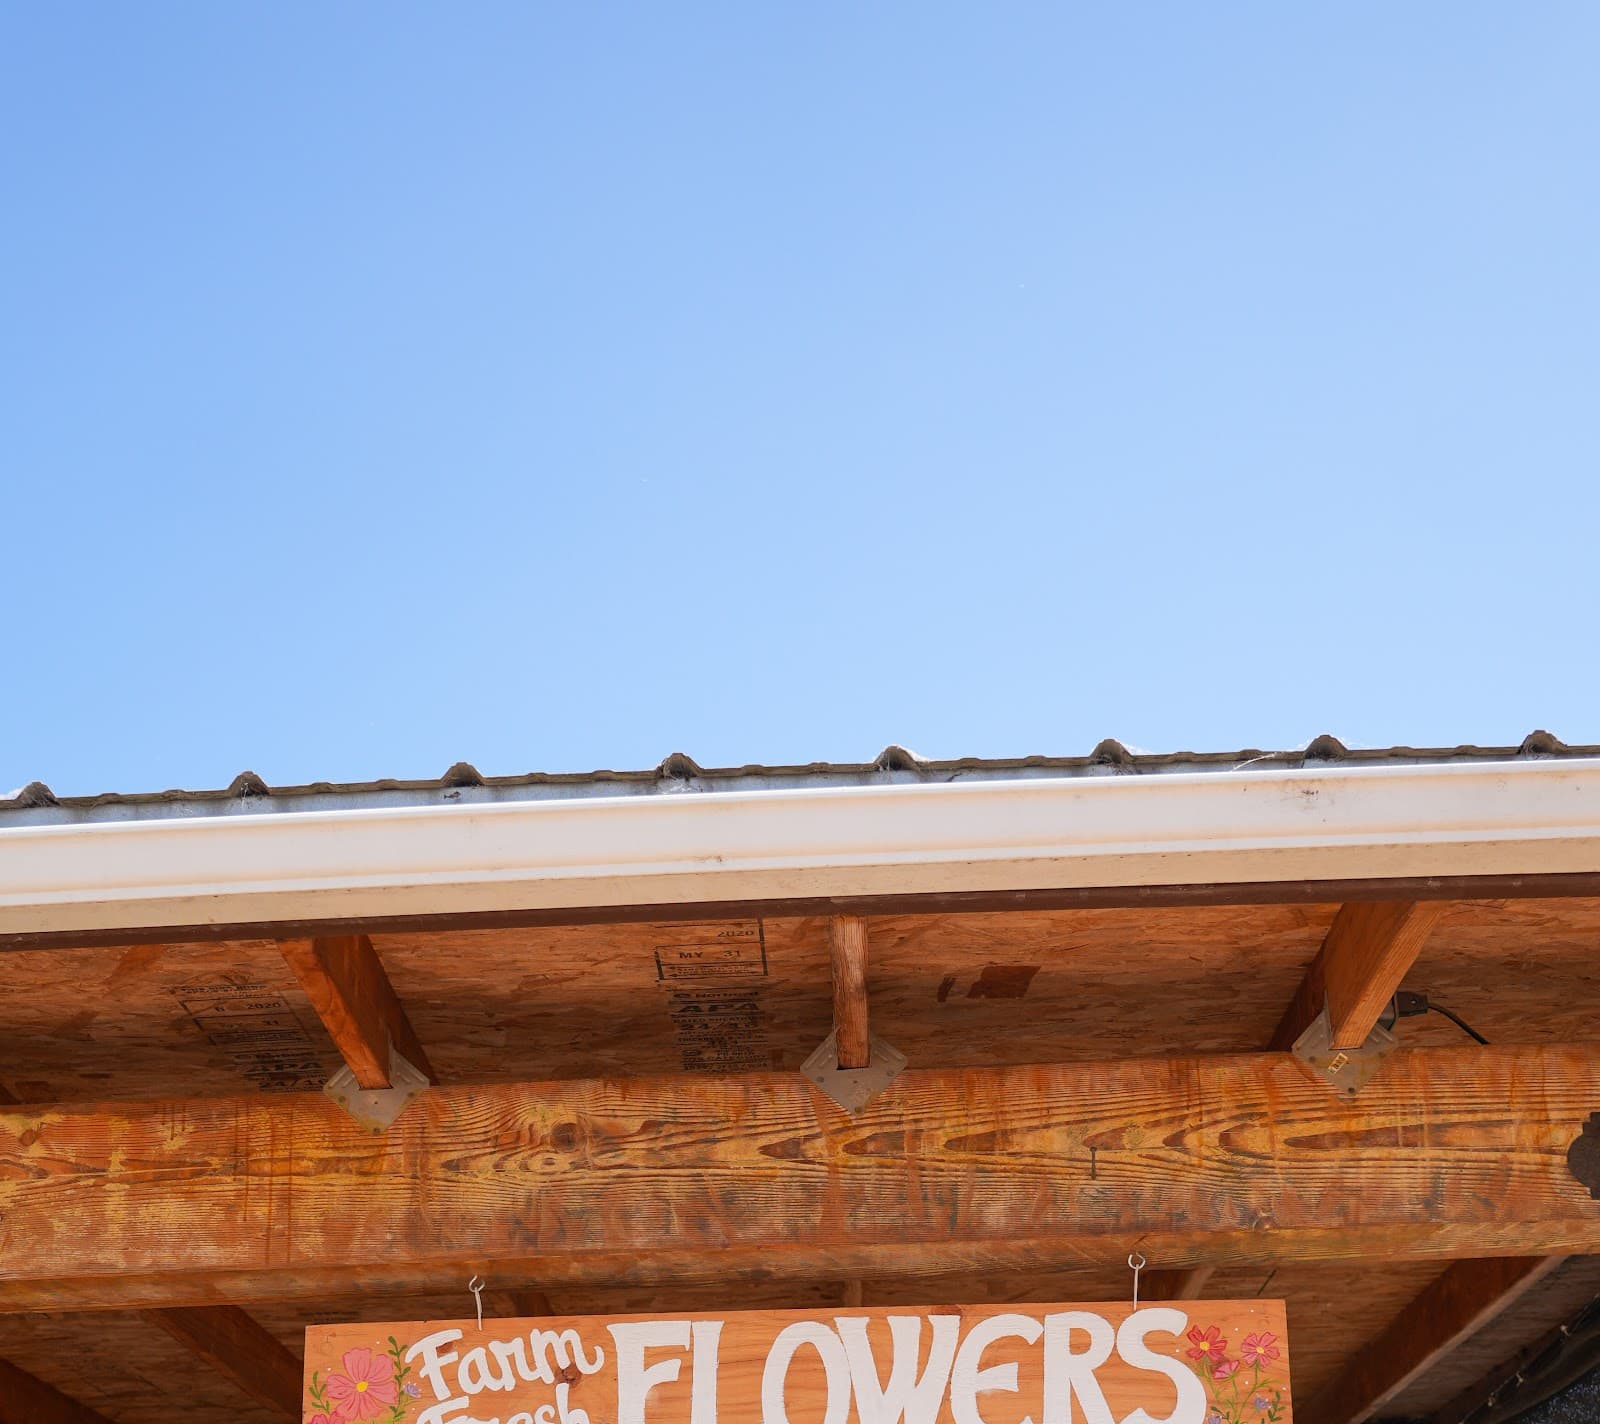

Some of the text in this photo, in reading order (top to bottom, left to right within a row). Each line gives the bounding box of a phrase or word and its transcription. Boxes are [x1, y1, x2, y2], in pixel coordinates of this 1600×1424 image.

[717, 929, 755, 938] 2020
[678, 949, 741, 959] MY 31
[246, 1001, 282, 1010] 2020
[678, 1003, 760, 1013] APA
[405, 1323, 605, 1400] Farm
